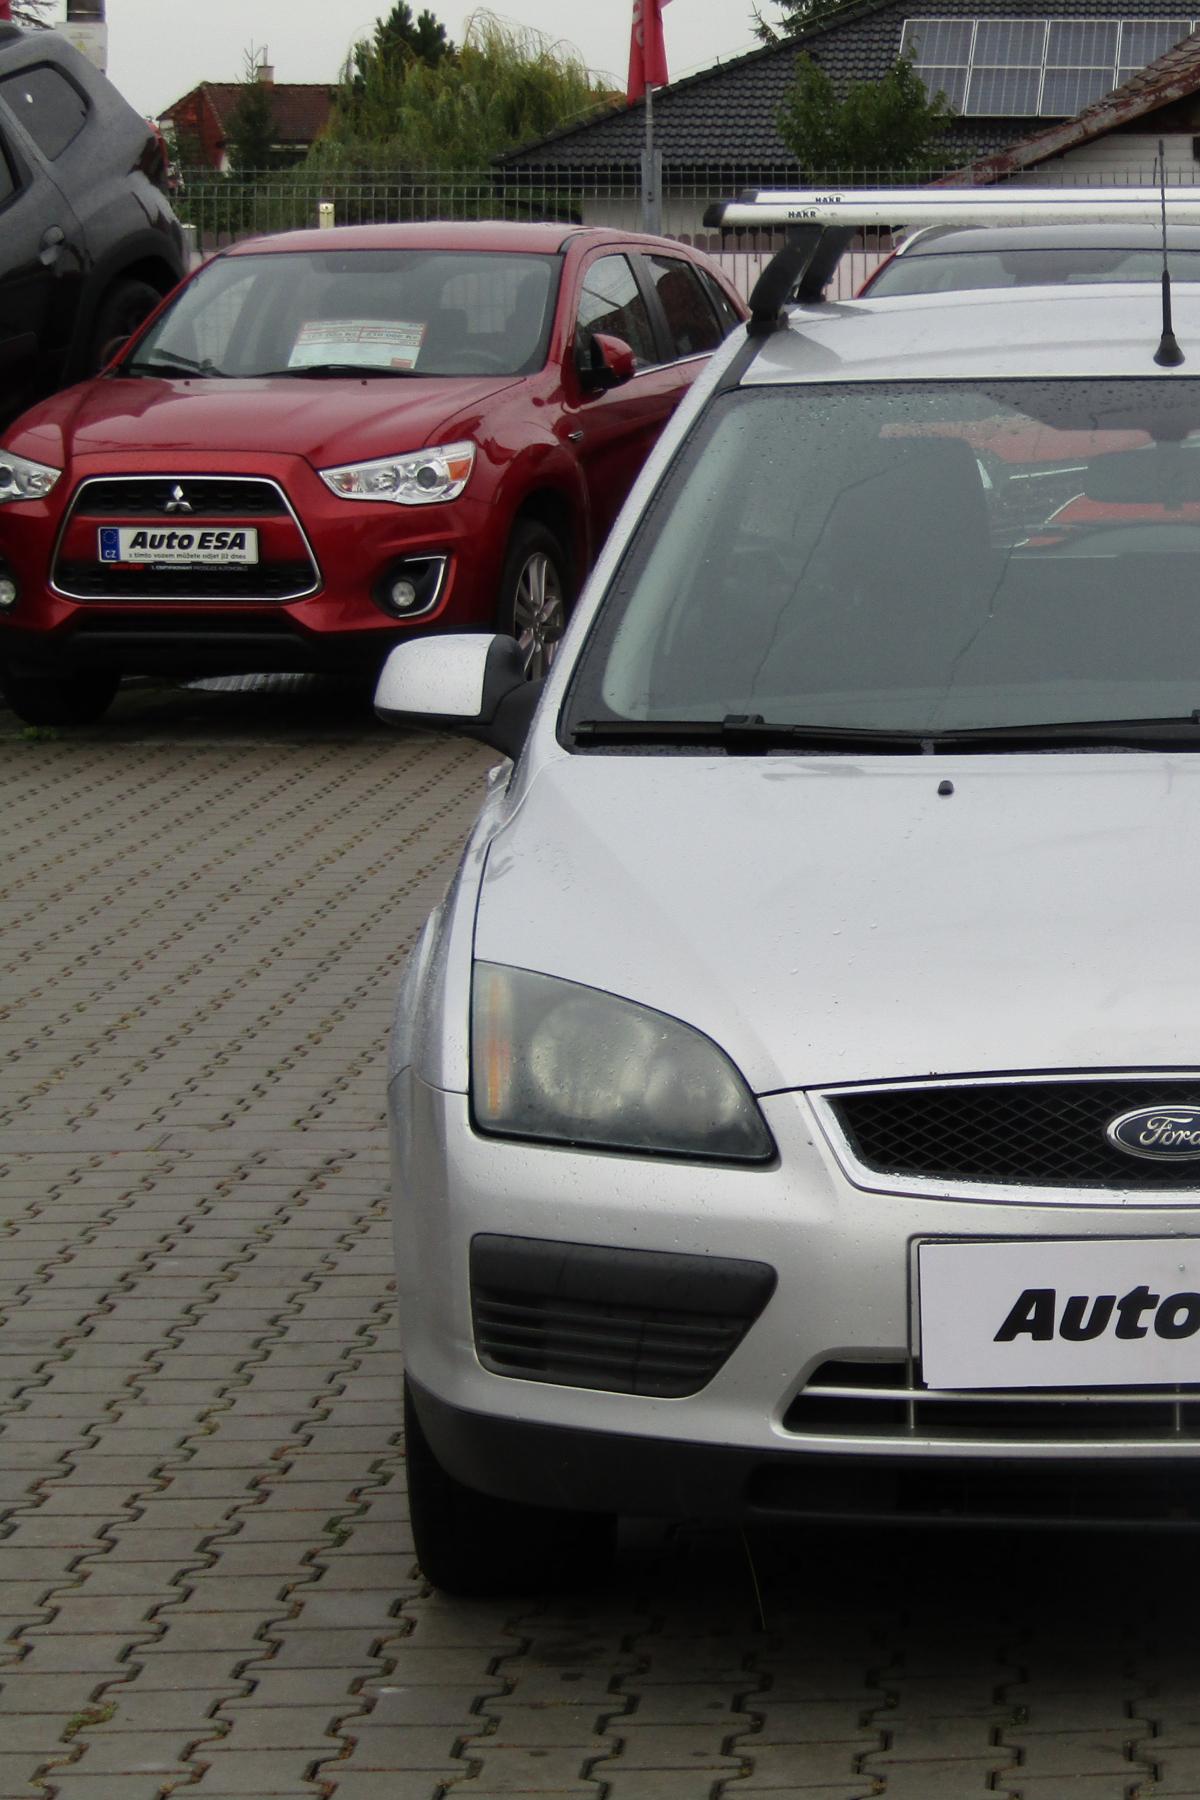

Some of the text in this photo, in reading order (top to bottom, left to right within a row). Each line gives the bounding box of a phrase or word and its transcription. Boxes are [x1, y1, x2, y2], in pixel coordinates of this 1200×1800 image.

[788, 210, 816, 218] HAKR
[129, 531, 246, 550] Auto ESA
[105, 550, 117, 559] CZ
